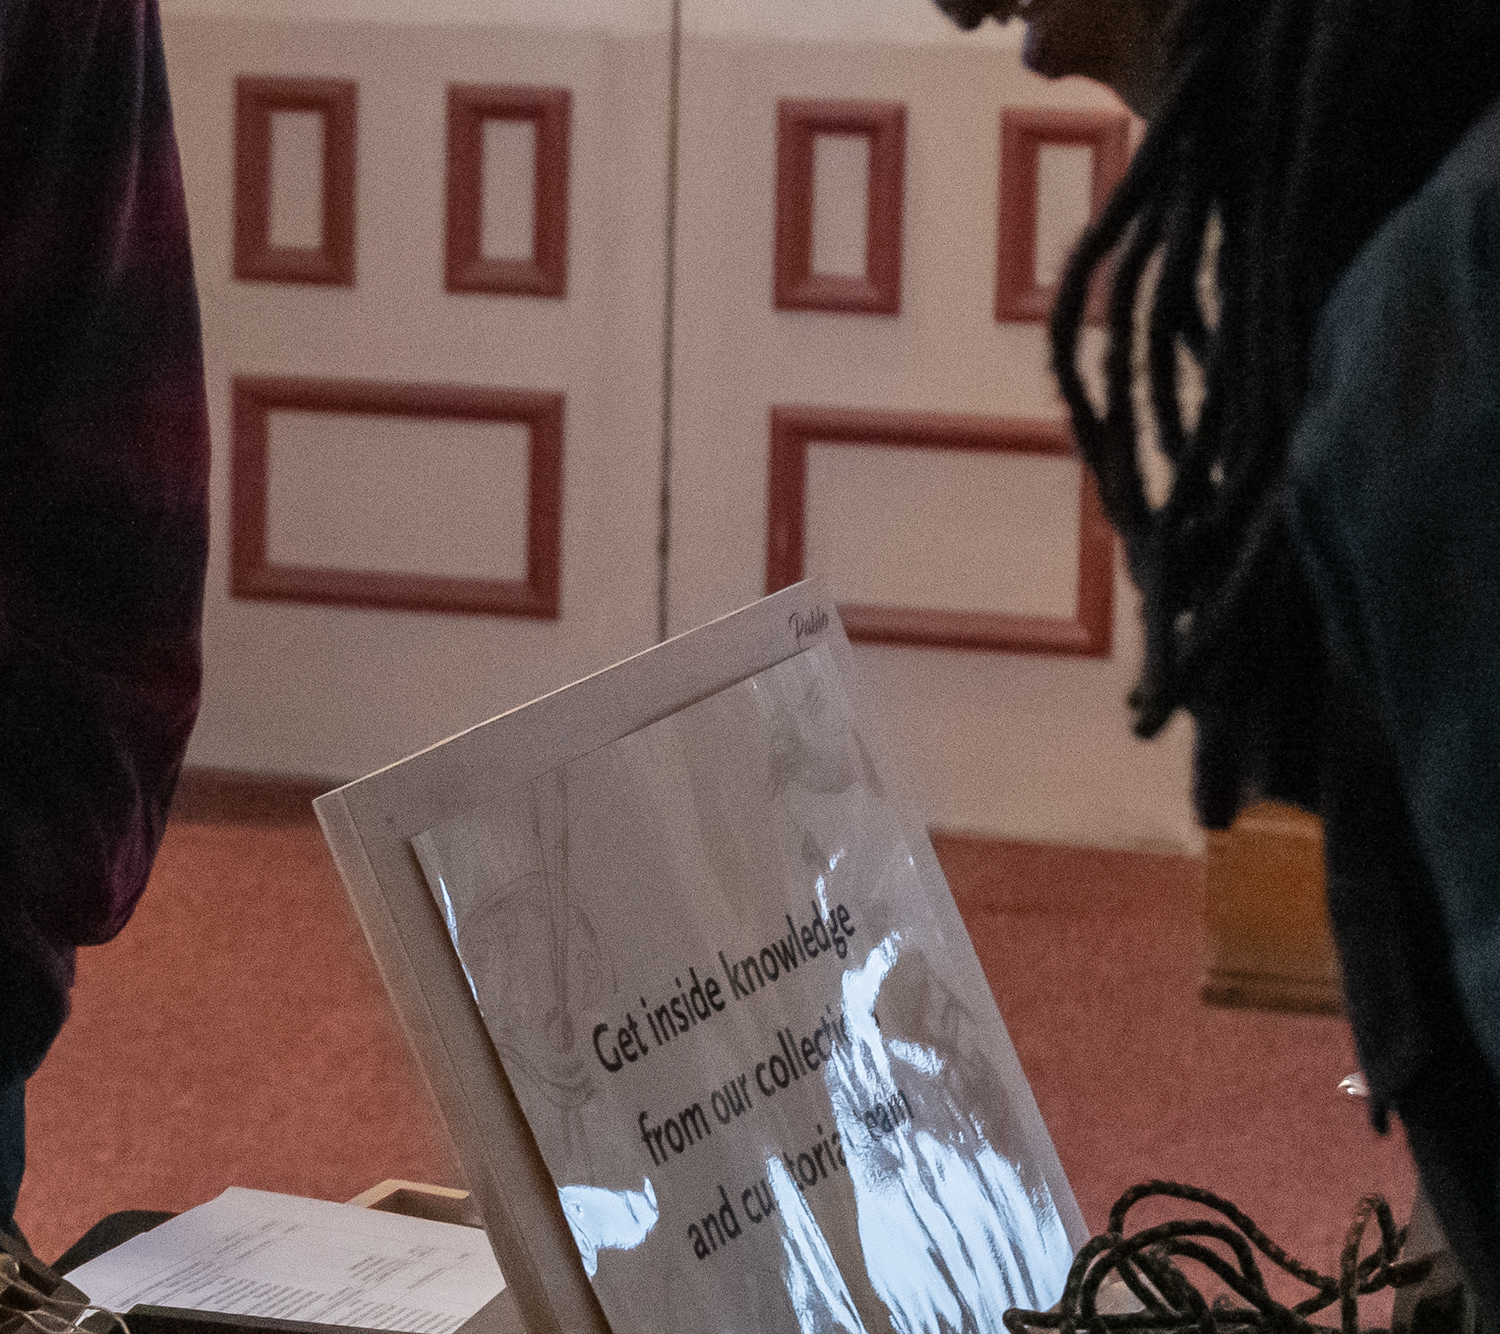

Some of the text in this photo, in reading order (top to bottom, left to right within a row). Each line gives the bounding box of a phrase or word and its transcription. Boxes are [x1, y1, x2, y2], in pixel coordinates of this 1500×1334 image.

[593, 900, 855, 1073] Get inside knowledge
[638, 1004, 880, 1167] from our collecti
[687, 1185, 742, 1260] and
